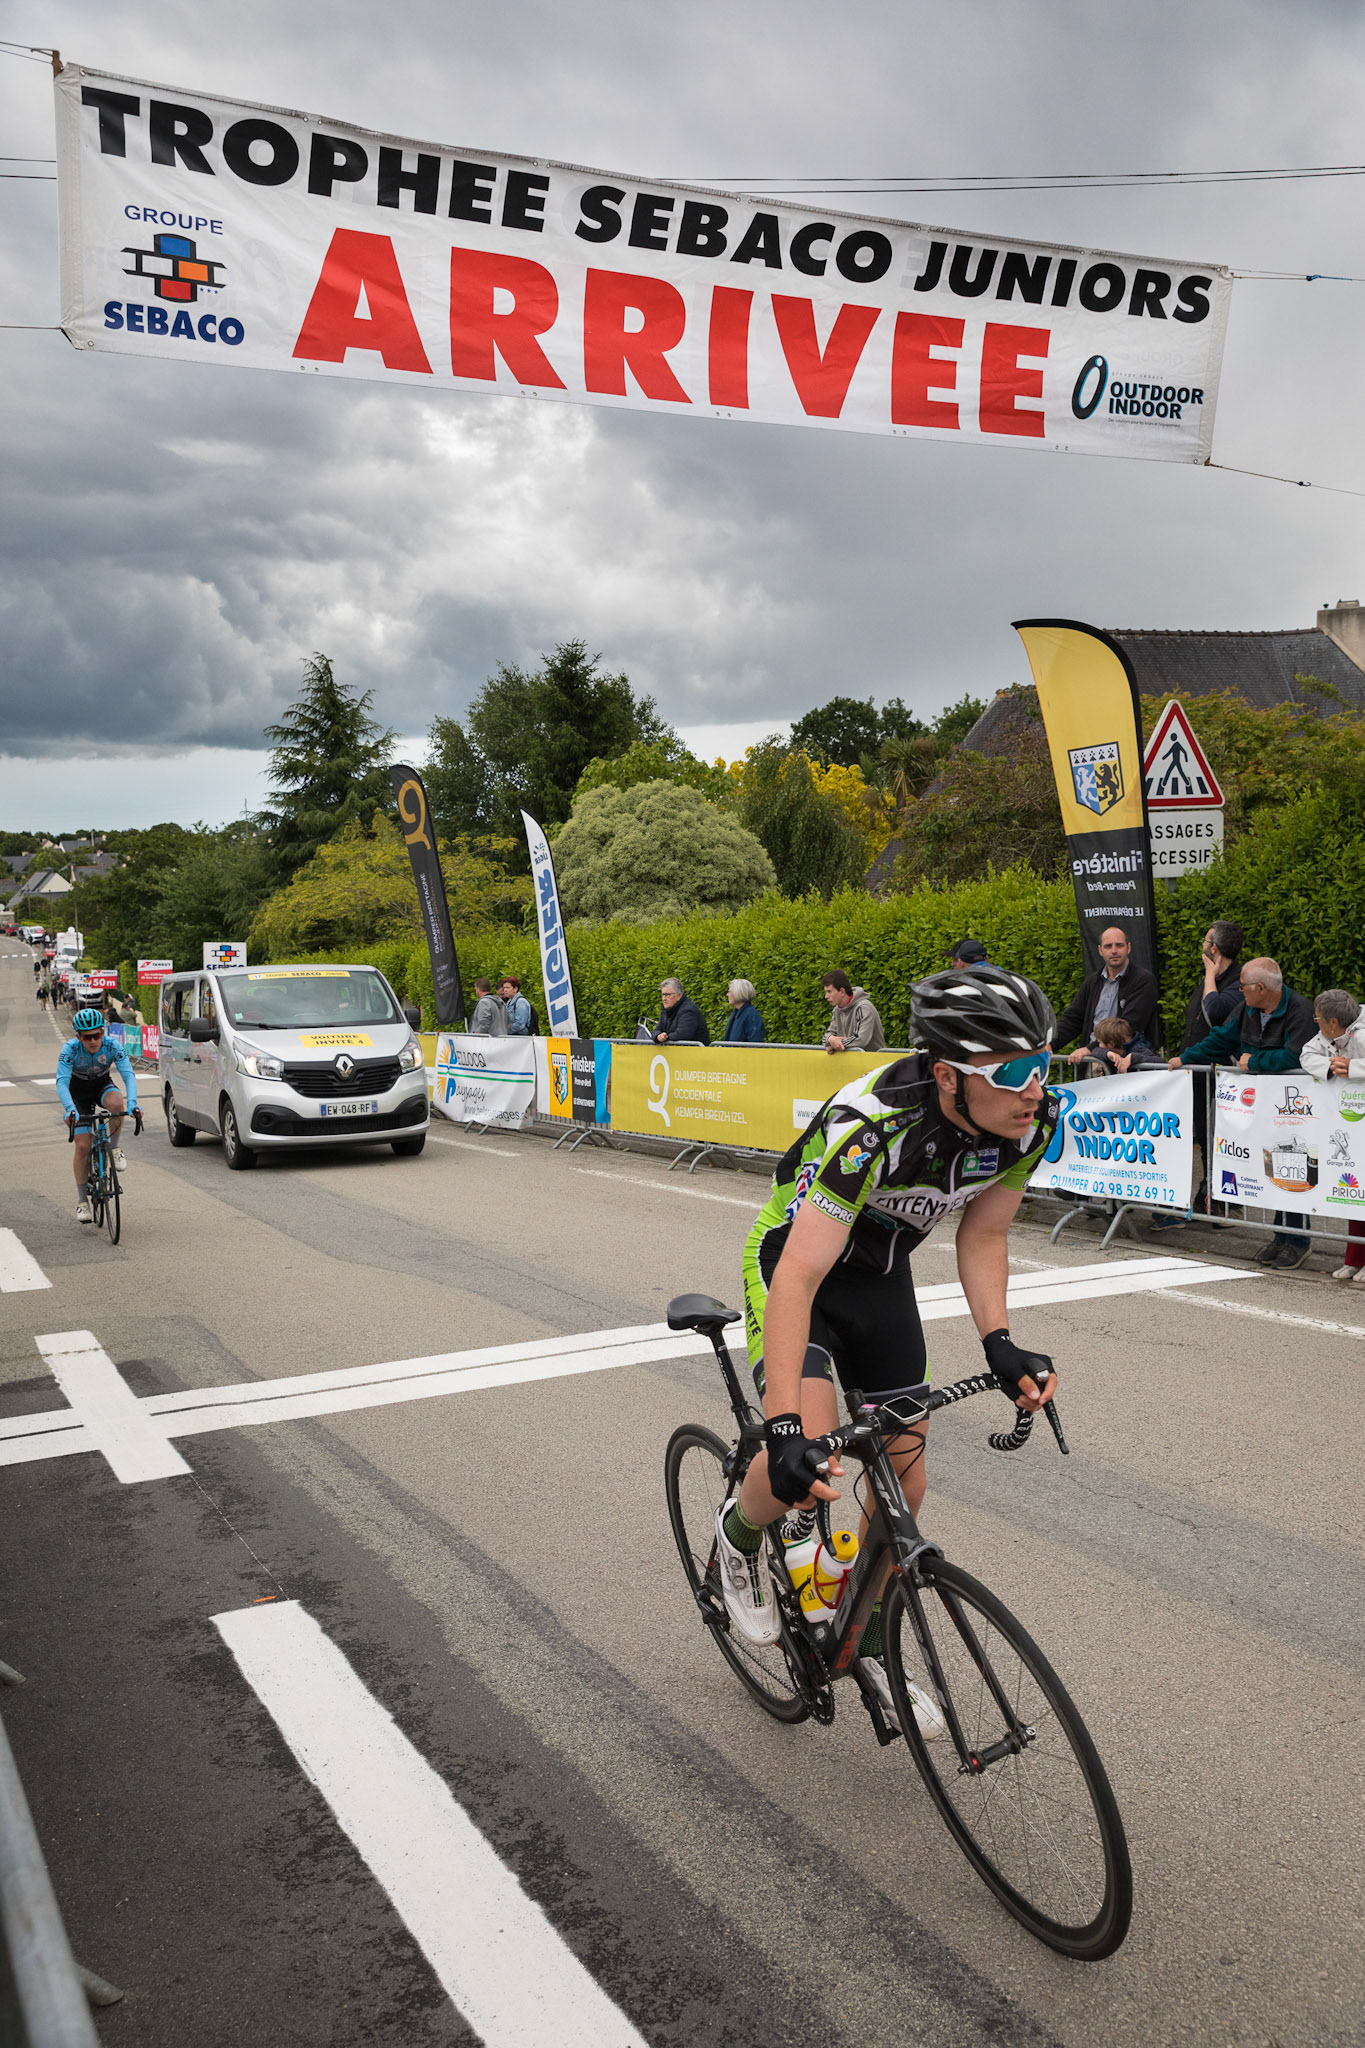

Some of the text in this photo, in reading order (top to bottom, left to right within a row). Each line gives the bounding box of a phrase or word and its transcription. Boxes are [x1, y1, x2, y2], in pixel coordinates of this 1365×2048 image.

[81, 86, 1214, 324] TROPHEE SEBACO JUNIORS
[124, 204, 224, 236] GROUPE
[104, 300, 245, 346] SEBACO
[292, 226, 1052, 439] ARRIVEE
[1110, 381, 1204, 405] OUTDOOR
[1108, 397, 1182, 420] INDOOR
[1149, 823, 1213, 839] SSAGES
[1151, 849, 1216, 865] CCESSIF
[93, 978, 105, 987] 50
[570, 1054, 596, 1073] Finistère
[674, 1070, 748, 1085] QUIMPER BRETAGNE
[673, 1088, 723, 1103] OCCIDENTALE
[1341, 1089, 1365, 1100] Quéré
[327, 1102, 371, 1116] EW-048-RF
[674, 1106, 748, 1124] KEMPER BREIZH IZEL
[1068, 1111, 1181, 1139] OUTDOOR
[1074, 1135, 1157, 1165] INDOOR
[1215, 1137, 1250, 1159] Kiclos
[1326, 1159, 1356, 1168] Garage RIO
[1098, 1167, 1138, 1179] EQUIPEMENTS
[1138, 1171, 1168, 1182] SPORTIFS
[1050, 1175, 1175, 1202] QUIMPER 02 98 52 69 12
[1244, 1190, 1258, 1198] BRIEC
[1332, 1186, 1365, 1199] PIRIOU
[811, 1190, 857, 1224] RMPRO
